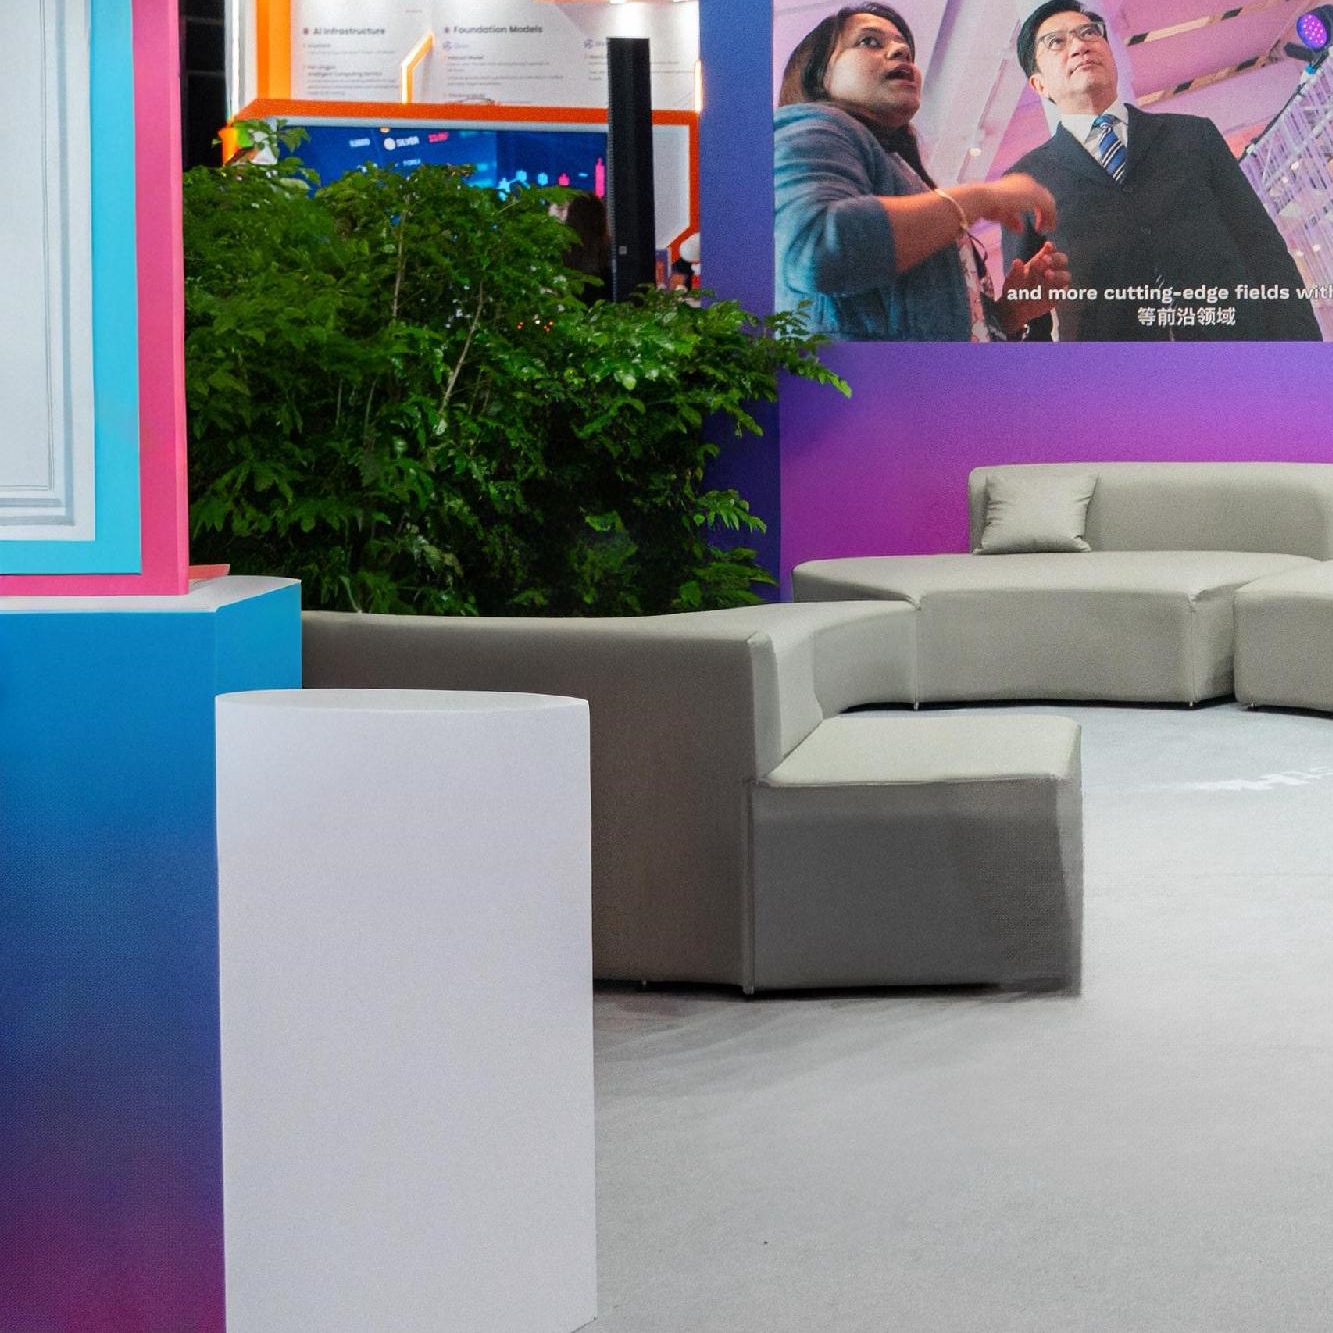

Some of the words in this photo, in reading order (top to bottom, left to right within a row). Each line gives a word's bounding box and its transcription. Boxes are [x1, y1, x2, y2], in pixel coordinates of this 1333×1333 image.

[453, 25, 507, 34] Foundation
[509, 25, 543, 34] Models
[1007, 285, 1042, 300] and
[1048, 288, 1097, 300] more
[1104, 285, 1229, 304] cutting-edge
[1235, 285, 1290, 300] fields
[1138, 307, 1236, 327] 等前沿领域
